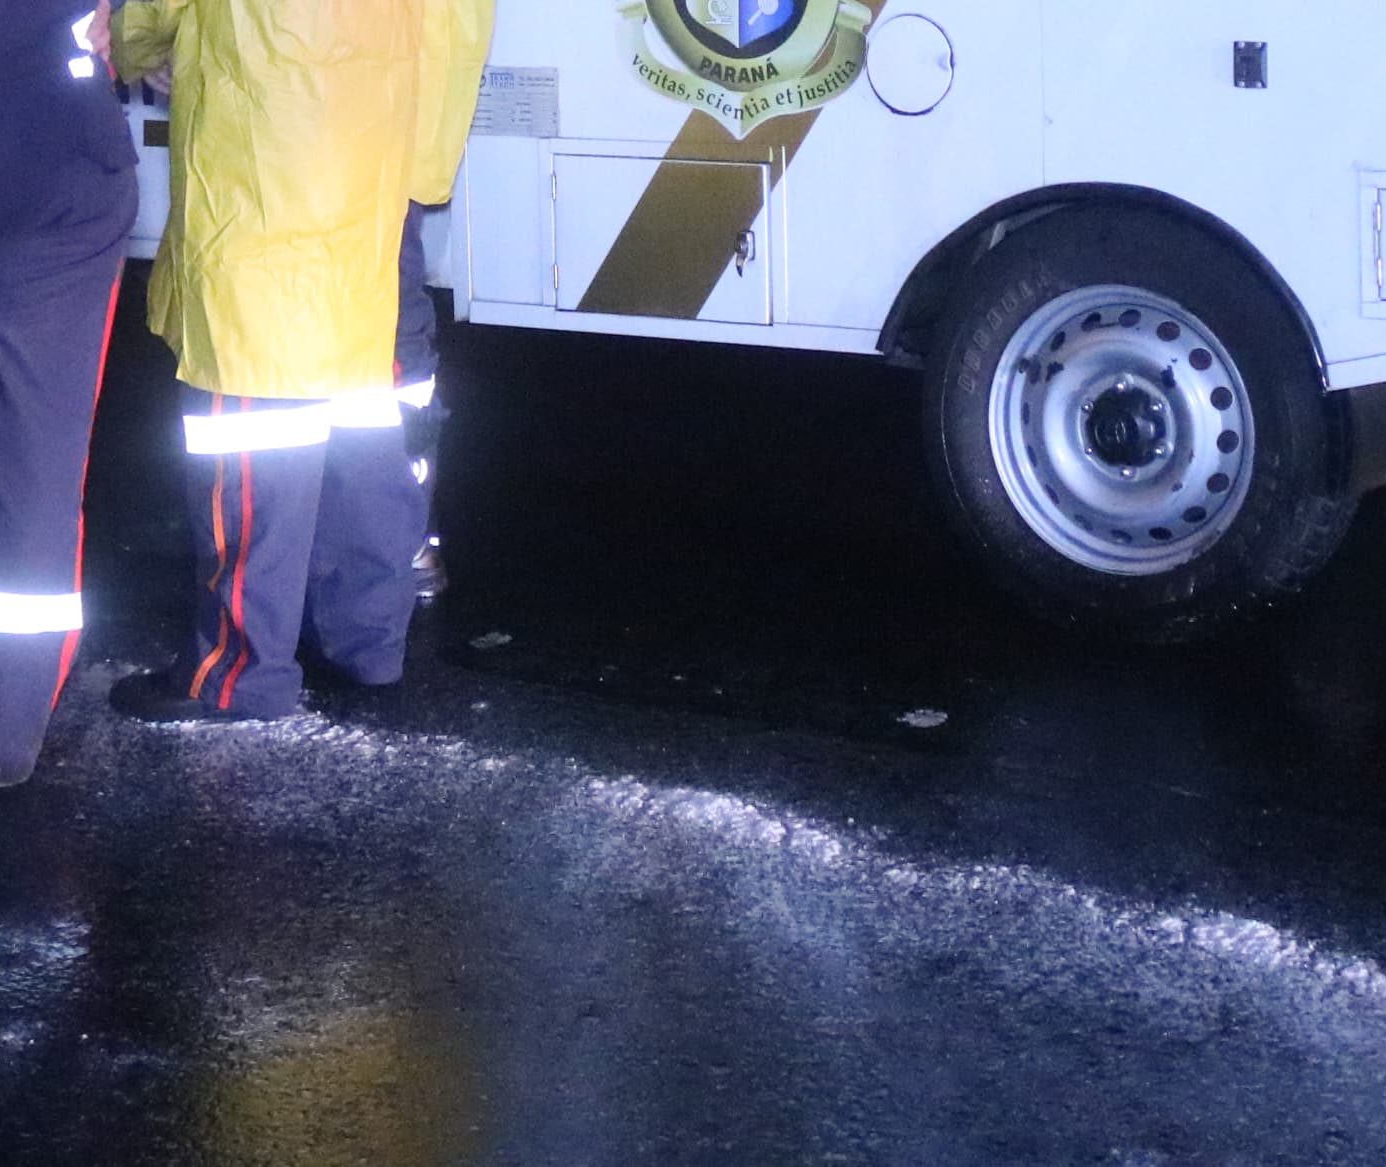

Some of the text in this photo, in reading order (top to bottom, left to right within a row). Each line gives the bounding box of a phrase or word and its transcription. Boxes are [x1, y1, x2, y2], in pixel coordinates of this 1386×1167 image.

[632, 52, 857, 121] veritas, scientia et justitia
[699, 55, 780, 84] PARANÁ
